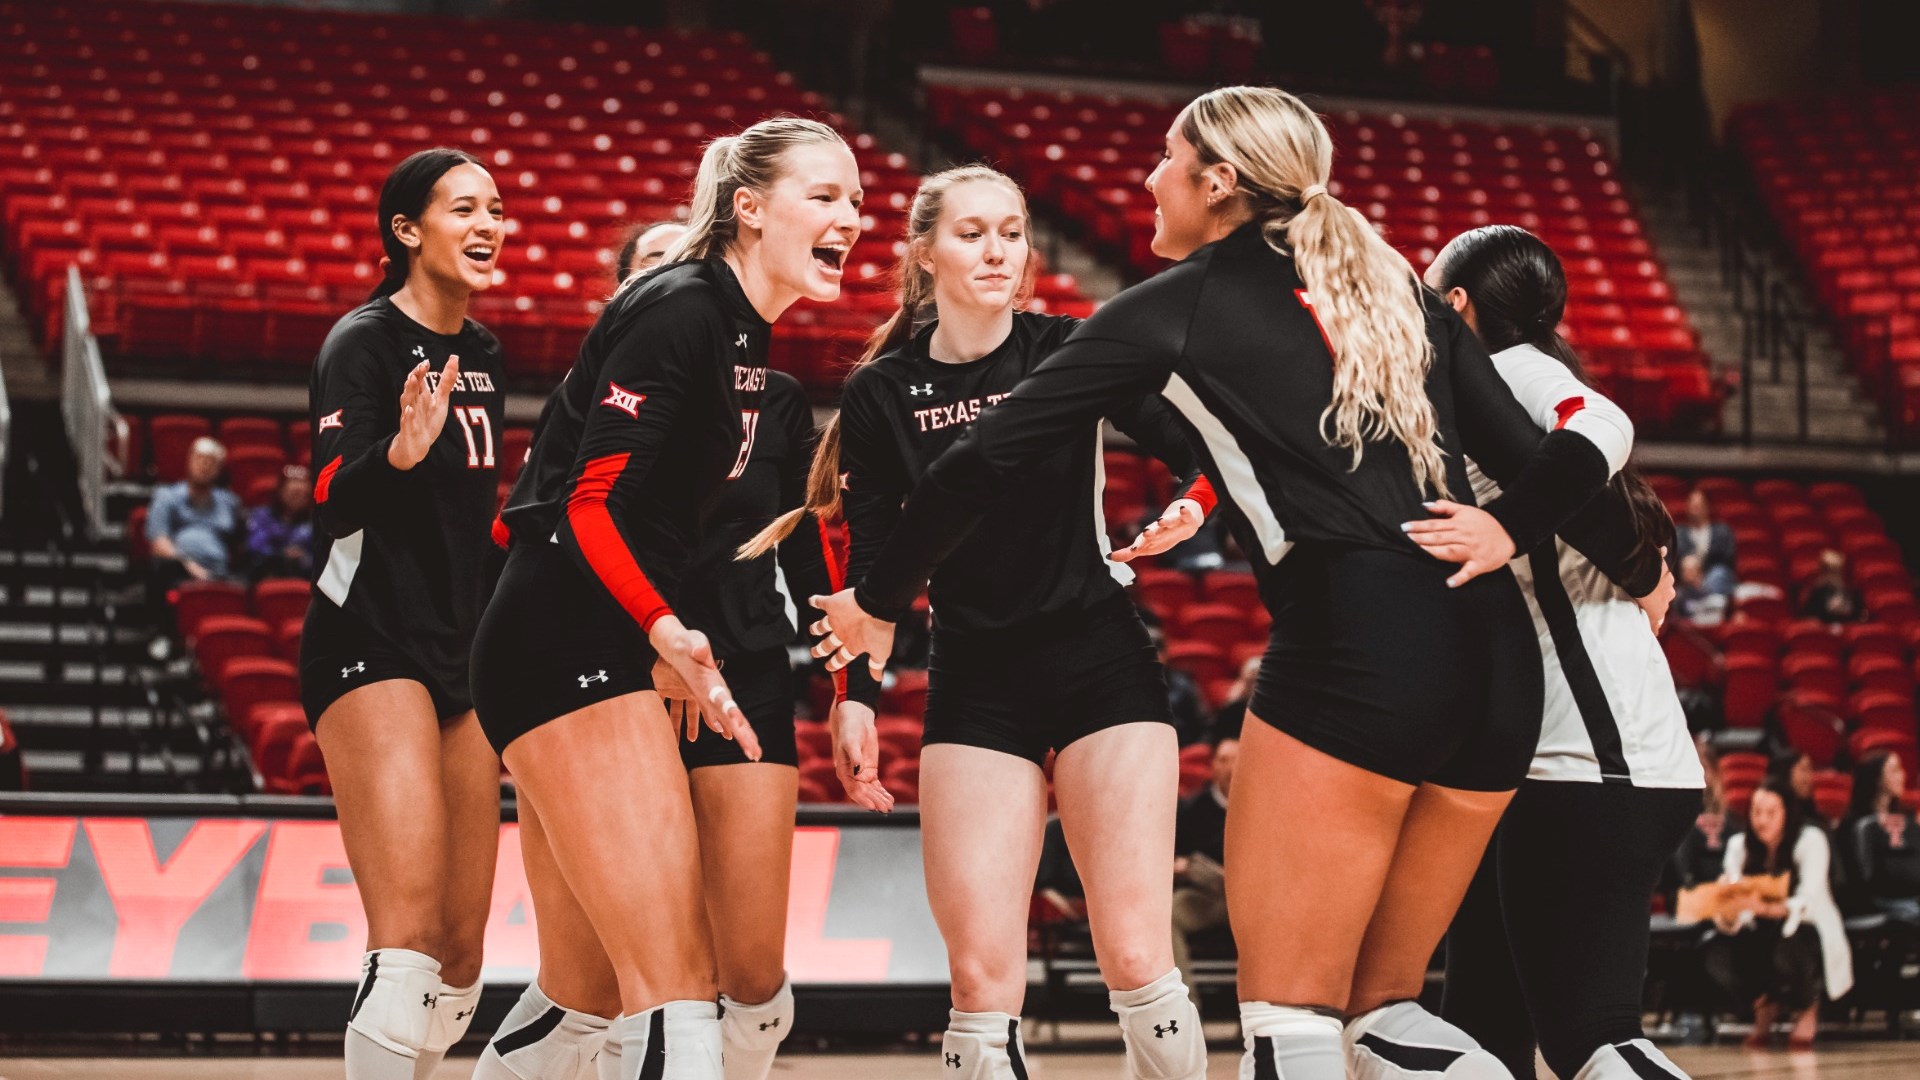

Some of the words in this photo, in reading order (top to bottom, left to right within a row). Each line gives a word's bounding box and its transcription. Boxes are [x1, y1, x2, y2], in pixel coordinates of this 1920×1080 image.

[463, 371, 495, 392] TECH
[733, 365, 760, 392] TEXAS
[914, 398, 981, 432] TEXAS
[453, 406, 495, 468] 17
[727, 409, 760, 480] 21
